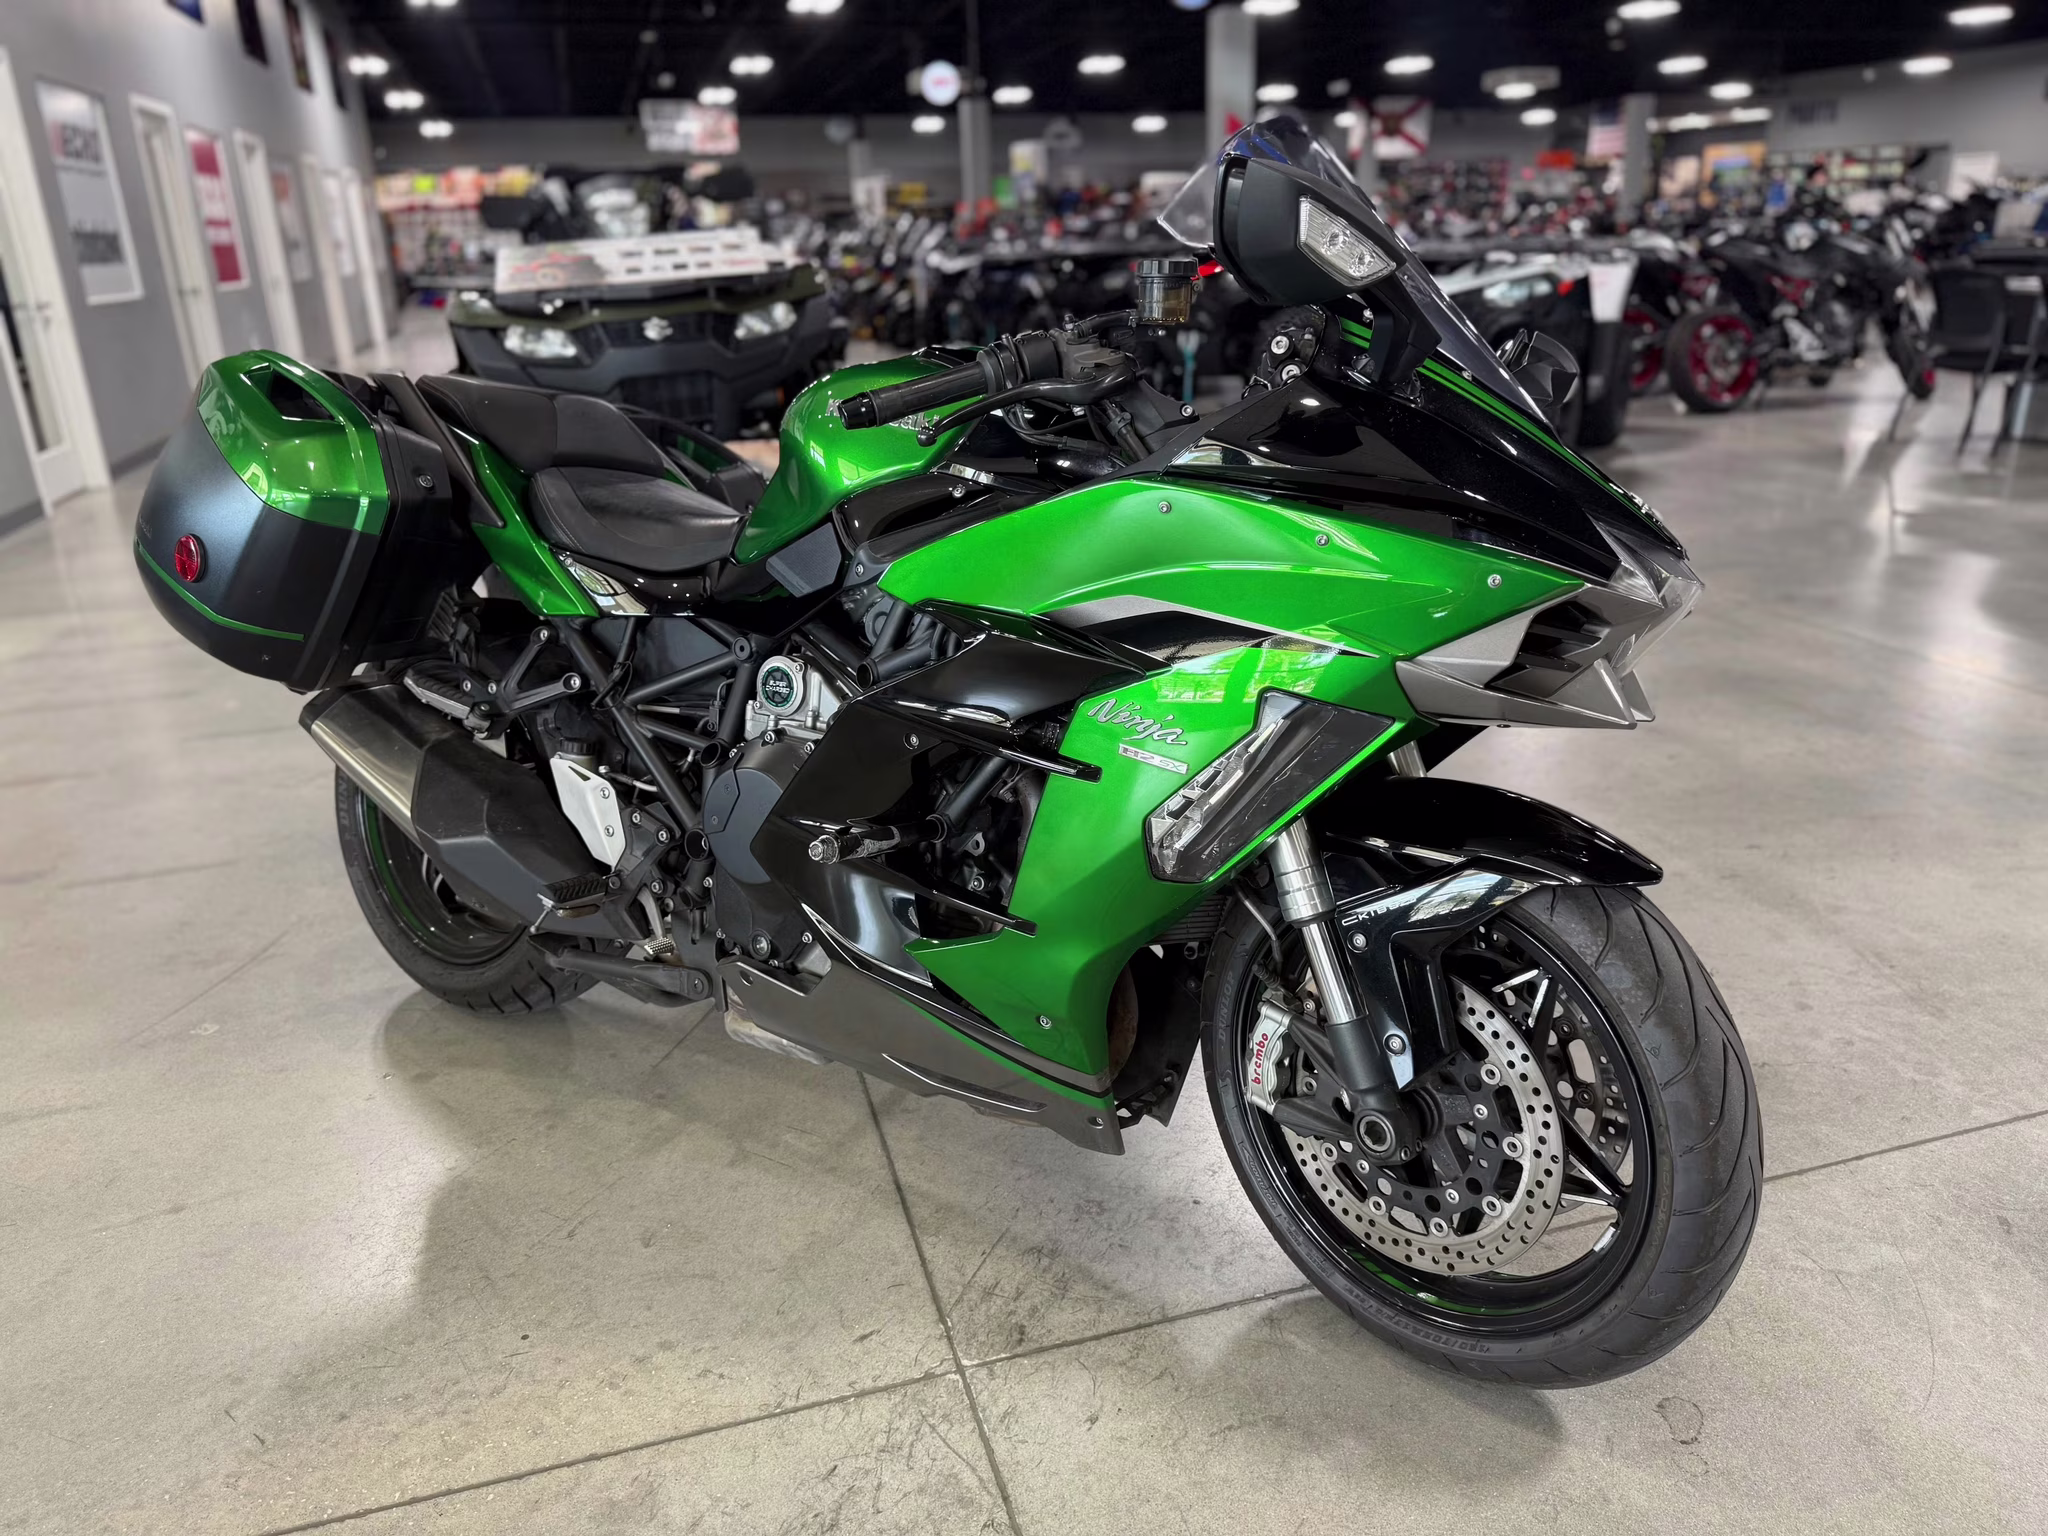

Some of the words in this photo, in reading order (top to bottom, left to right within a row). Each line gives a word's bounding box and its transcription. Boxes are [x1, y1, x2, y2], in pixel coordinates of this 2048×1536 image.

[1087, 698, 1188, 746] Ninja
[1121, 746, 1155, 763] H2
[1158, 759, 1185, 772] SX
[1217, 969, 1236, 1043] DUNLOP
[1251, 1033, 1269, 1085] brembo
